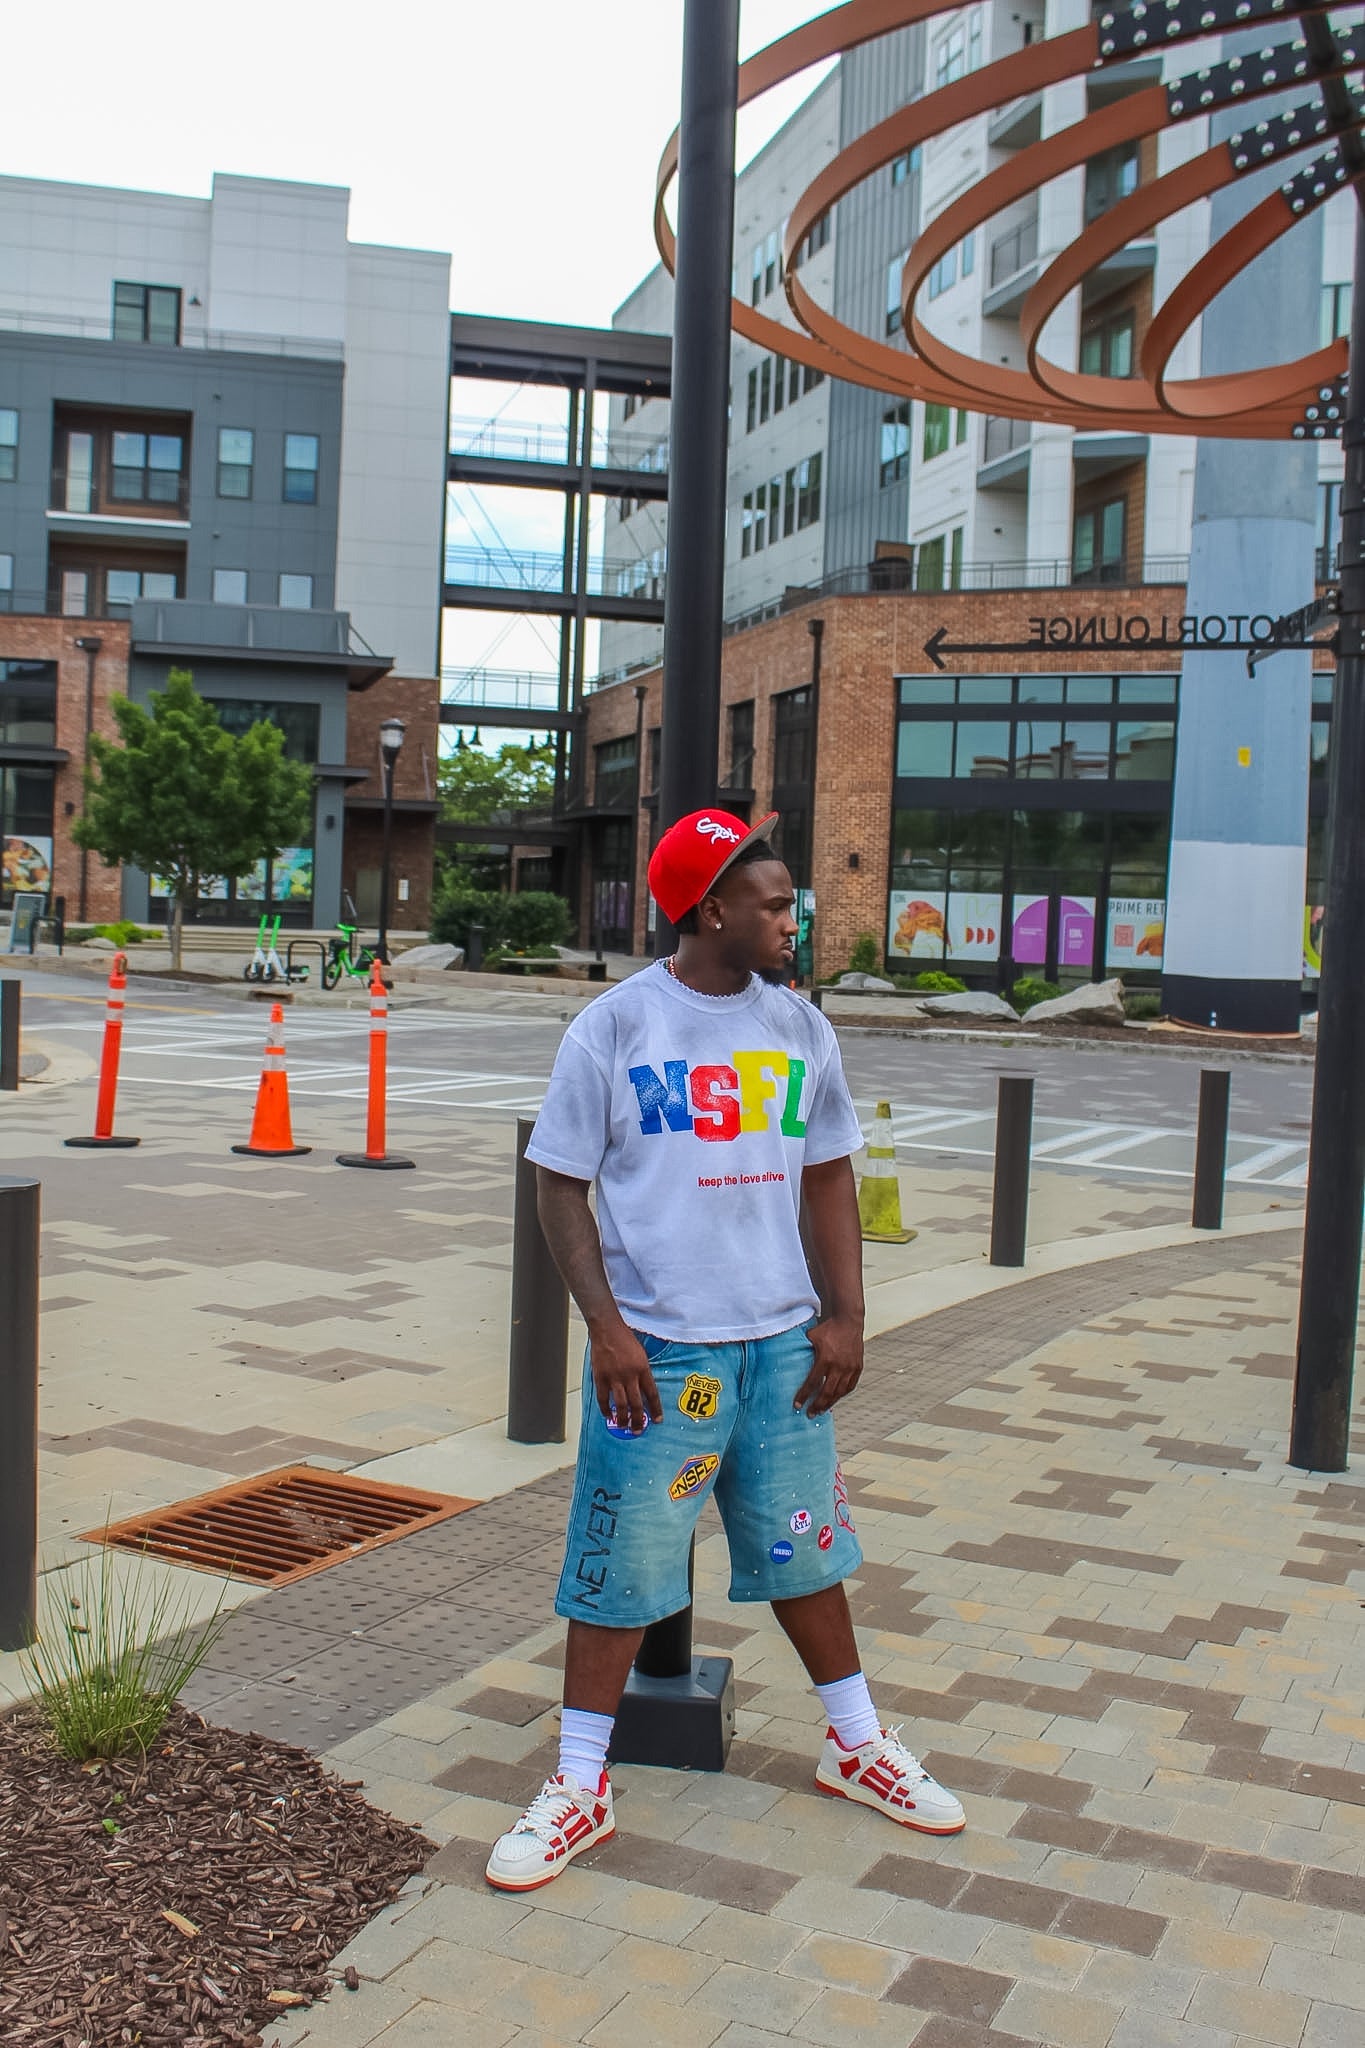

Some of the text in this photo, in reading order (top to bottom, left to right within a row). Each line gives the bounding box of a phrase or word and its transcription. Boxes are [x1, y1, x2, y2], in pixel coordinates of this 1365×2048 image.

[1109, 901, 1142, 915] PRIME
[628, 1051, 806, 1142] NSFL
[698, 1171, 785, 1188] keep the love alive
[688, 1377, 719, 1392] NEVER
[686, 1389, 712, 1416] 82
[572, 1487, 622, 1609] NEVER
